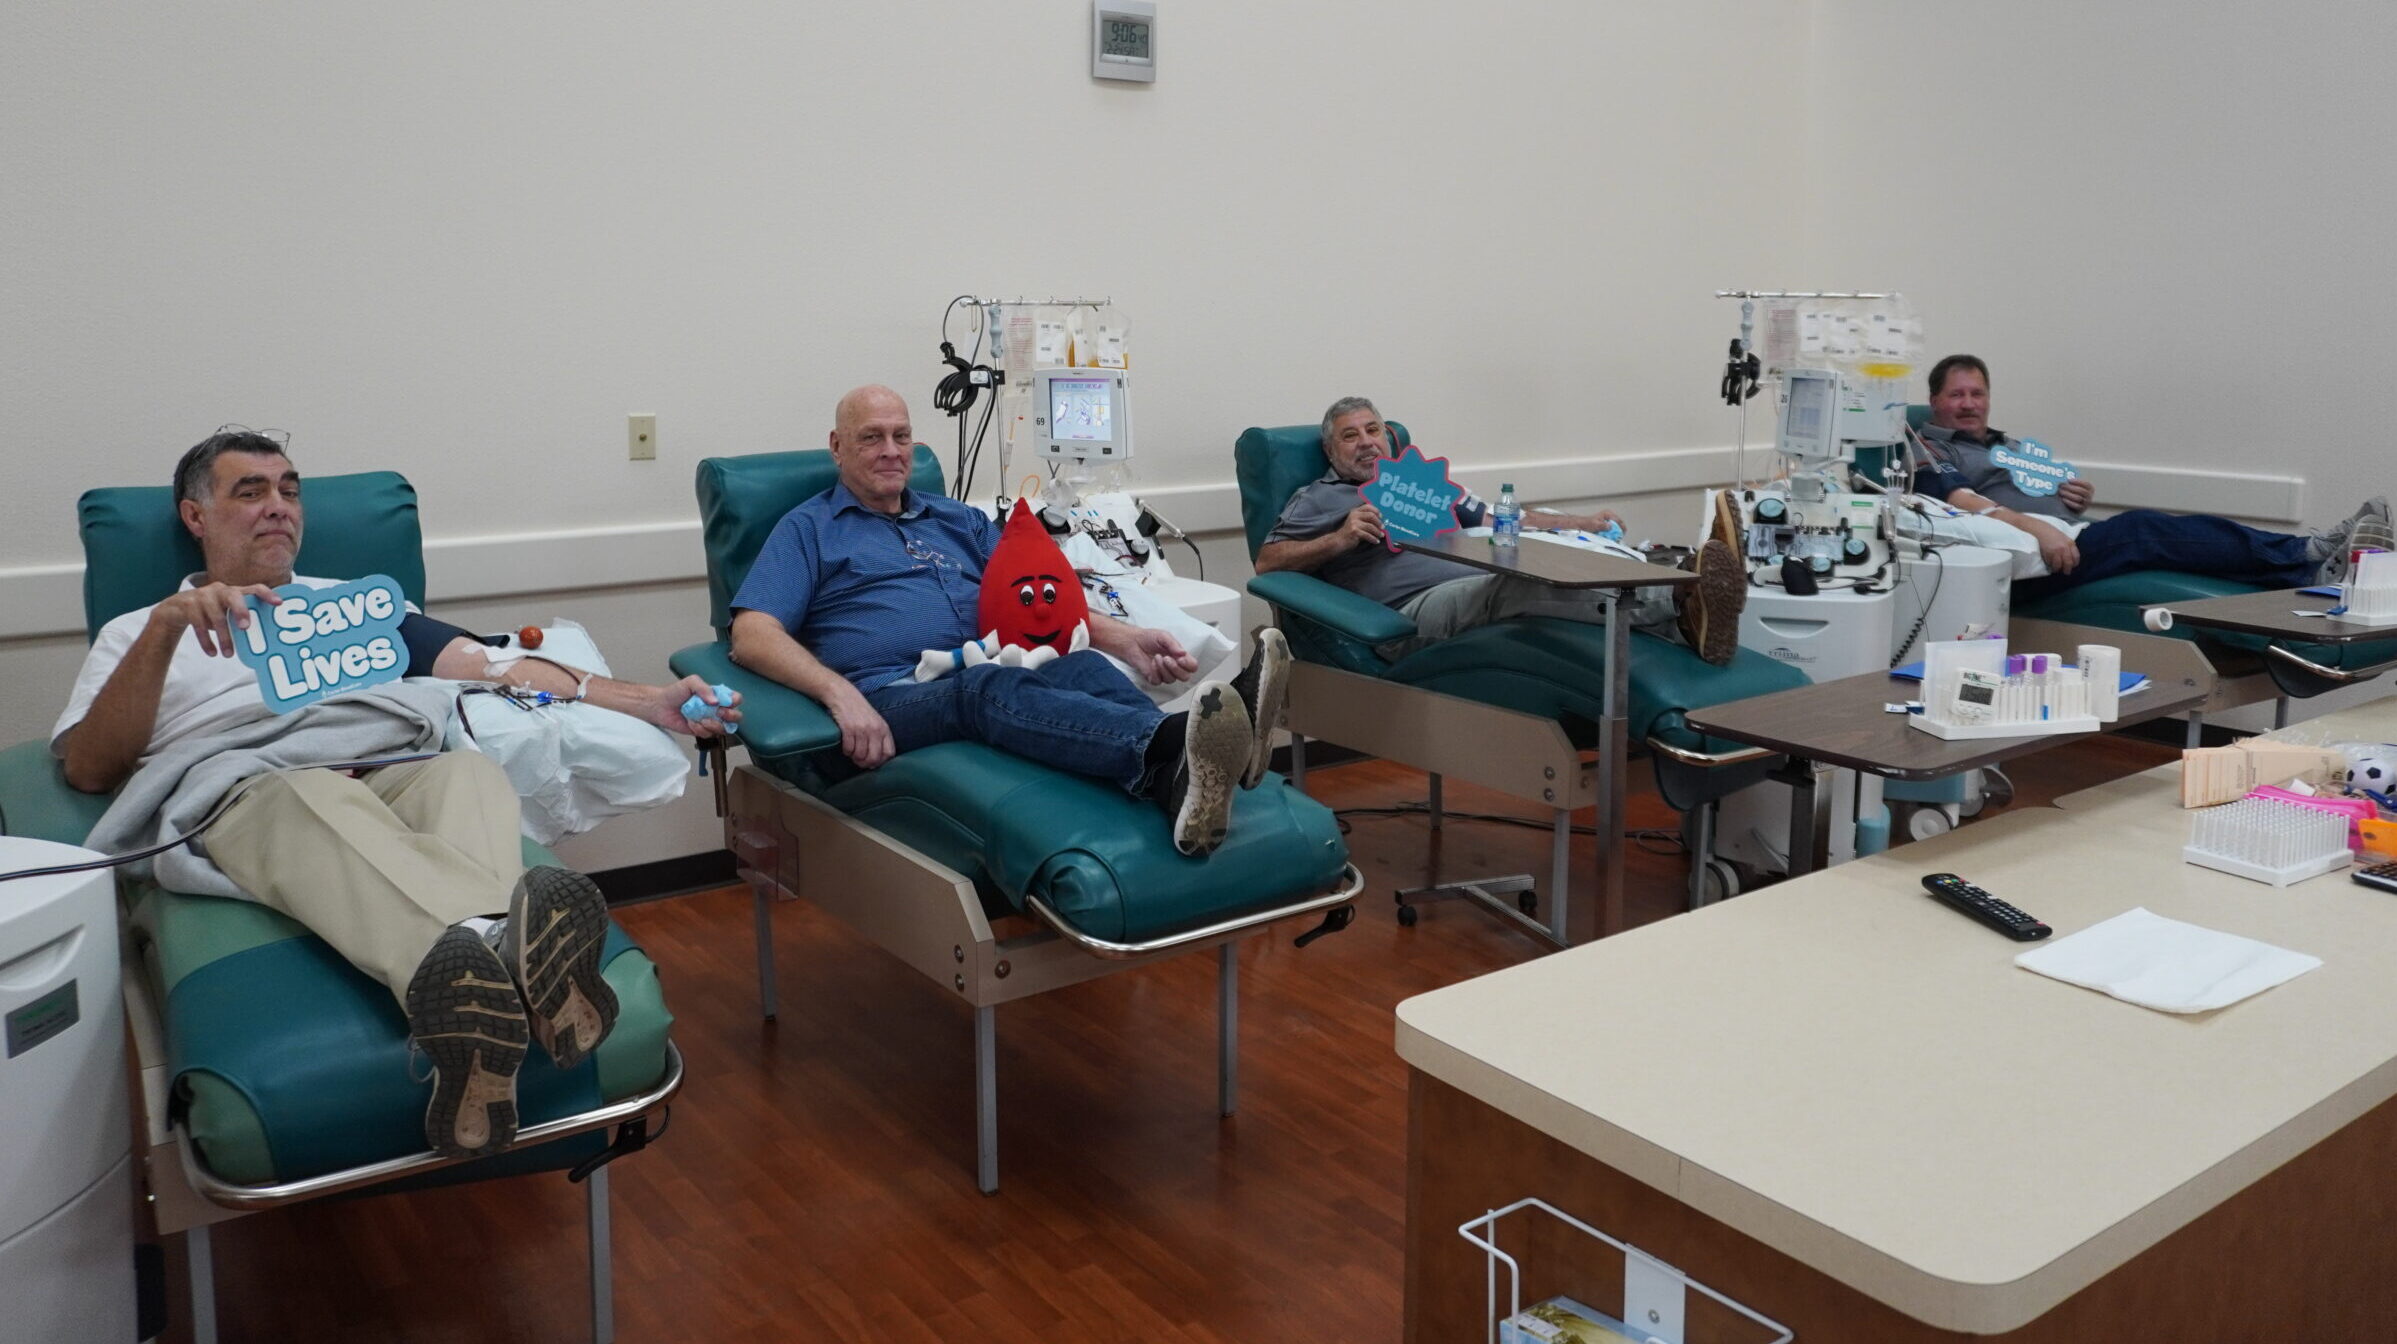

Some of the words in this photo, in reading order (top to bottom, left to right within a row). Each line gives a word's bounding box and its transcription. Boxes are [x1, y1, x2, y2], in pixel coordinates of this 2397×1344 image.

[1036, 417, 1045, 426] 69
[1996, 450, 2075, 480] Someone's
[2025, 442, 2048, 458] I'm
[1379, 472, 1451, 511] Platelet
[2016, 470, 2053, 490] Type
[1380, 491, 1437, 524] Donor
[245, 609, 267, 655] I
[273, 587, 394, 645] Save
[268, 637, 397, 700] Lives
